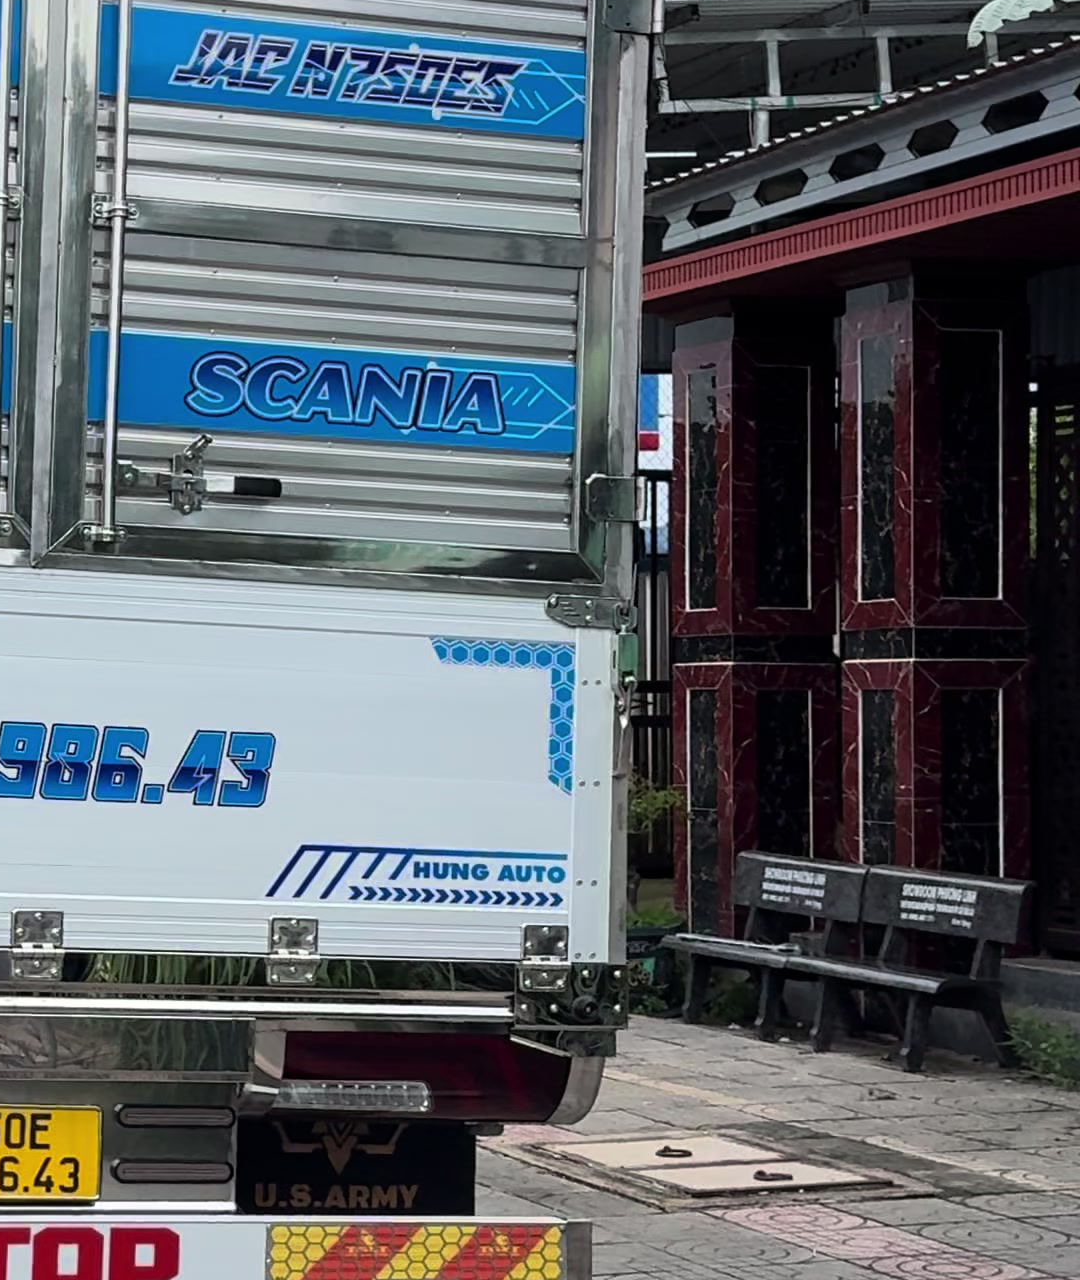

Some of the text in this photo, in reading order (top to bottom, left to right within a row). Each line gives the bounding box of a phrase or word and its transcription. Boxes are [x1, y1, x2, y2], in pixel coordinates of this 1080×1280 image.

[168, 28, 299, 95] JAC
[183, 351, 506, 435] SCANIA
[497, 864, 566, 884] AUTO
[255, 1183, 419, 1209] U.S.ARMY
